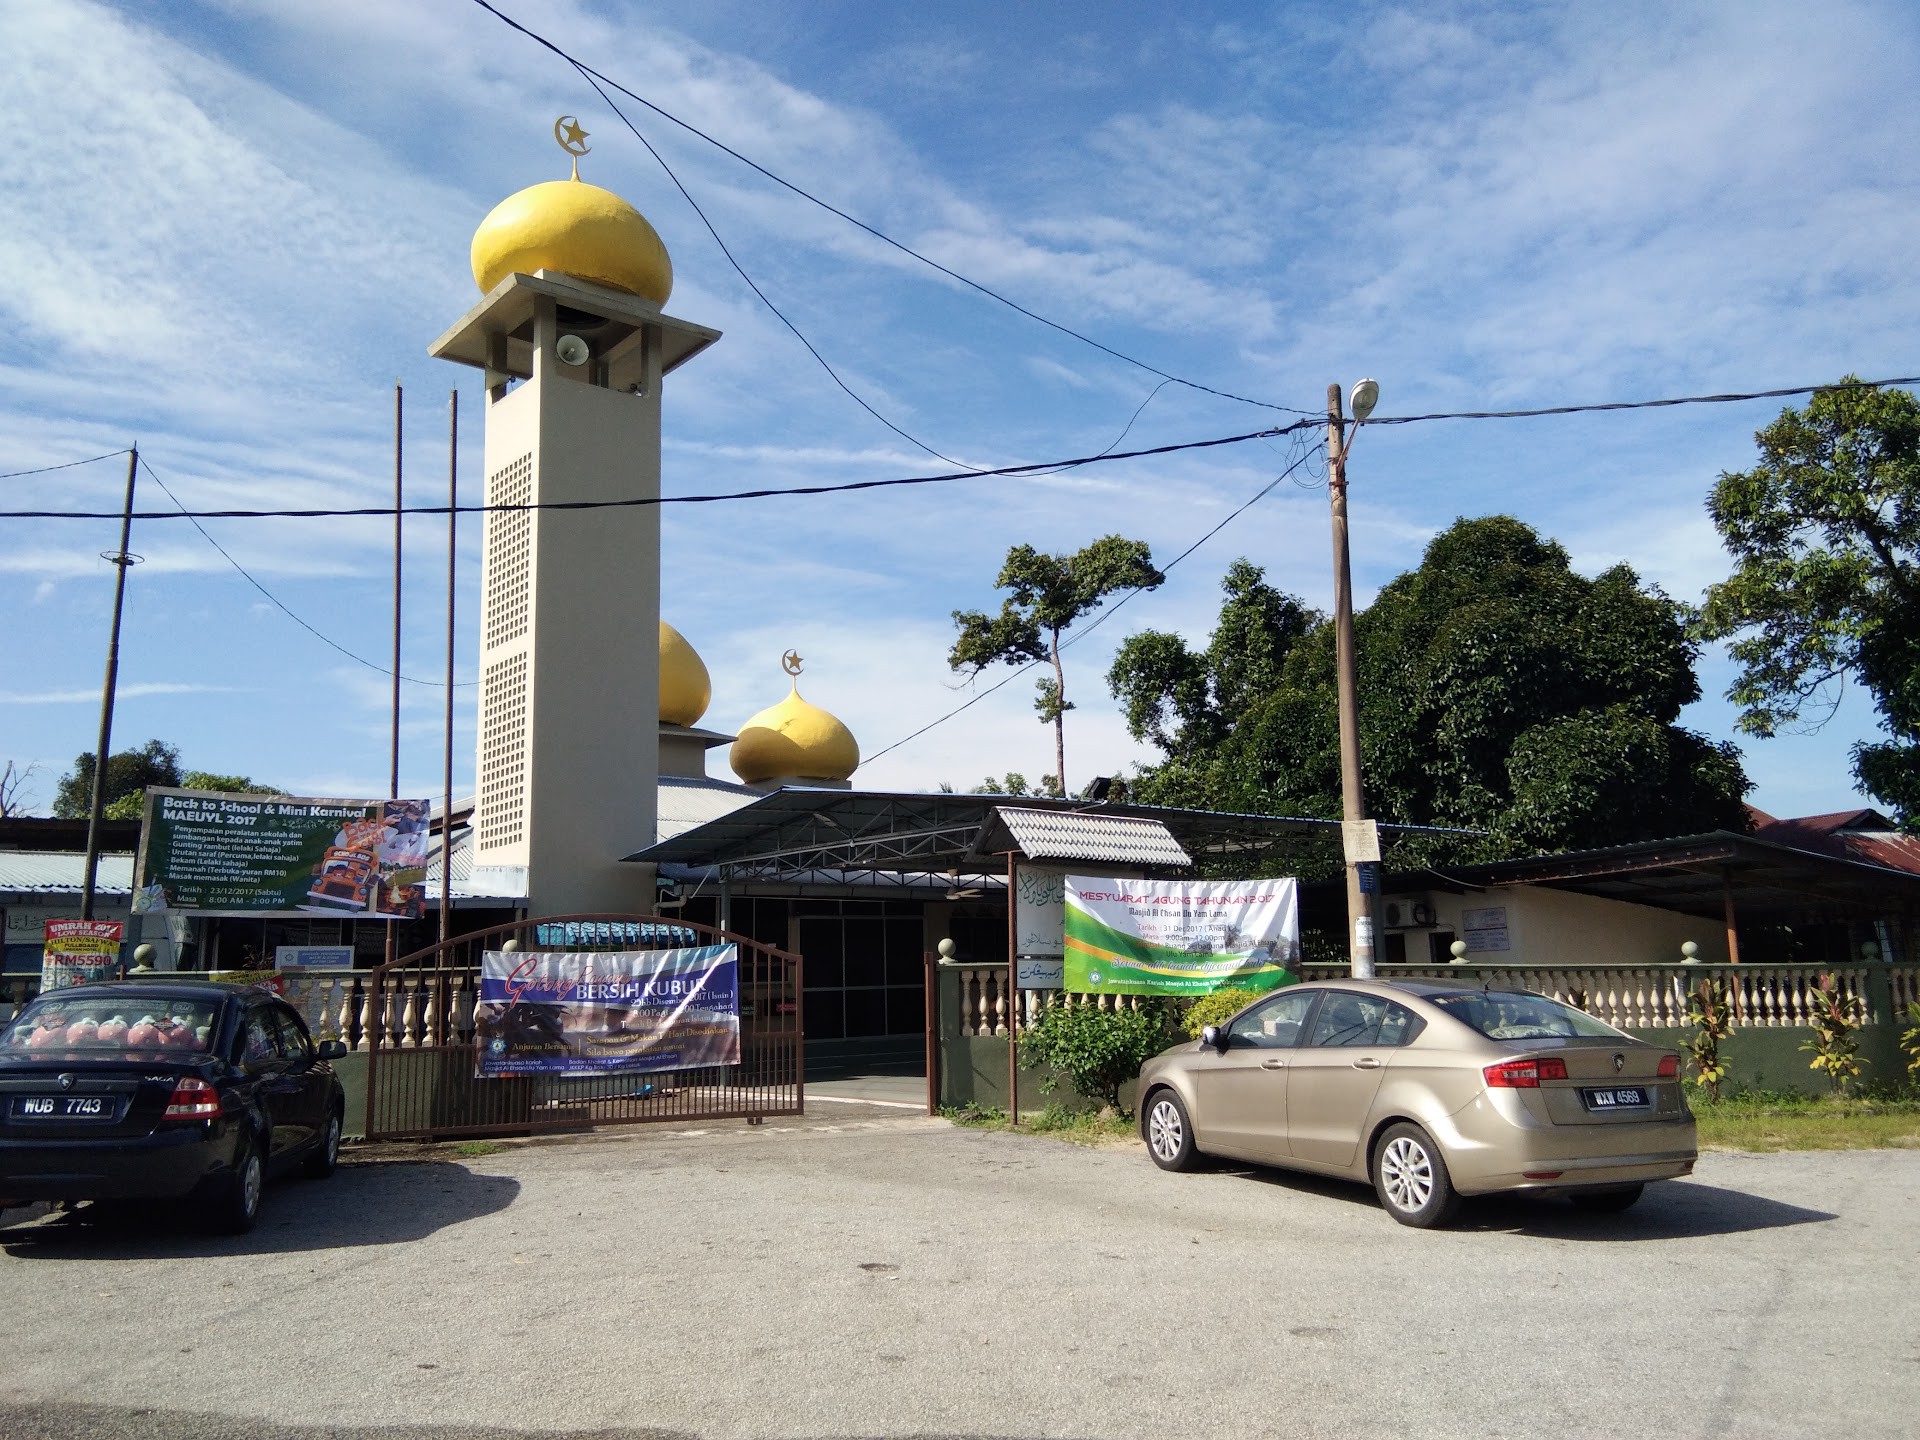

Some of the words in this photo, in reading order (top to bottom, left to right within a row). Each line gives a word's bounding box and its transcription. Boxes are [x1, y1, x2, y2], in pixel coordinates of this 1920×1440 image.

[163, 797, 199, 810] Back
[202, 801, 216, 811] to
[220, 801, 261, 814] School
[264, 804, 275, 815] &
[279, 805, 306, 816] Mini
[310, 807, 367, 818] Karnival
[163, 809, 223, 823] MAEUYL
[226, 815, 258, 826] 2017
[175, 825, 223, 835] Penyampaian
[225, 829, 260, 837] peralatan
[260, 829, 288, 838] sekolah
[289, 831, 302, 839] dan
[172, 841, 202, 850] Gunting
[204, 842, 230, 850] rambut
[173, 833, 215, 843] sumbangan
[216, 835, 243, 844] kepada
[244, 837, 281, 846] anak-anak
[282, 839, 302, 847] yatim
[172, 848, 197, 857] Urutan
[198, 850, 217, 858] saraf
[170, 864, 206, 873] Memanah
[264, 868, 287, 877] RM10)
[168, 872, 192, 880] Masak
[193, 874, 228, 882] memasak
[230, 875, 260, 884] (Wanita)
[210, 887, 254, 896] 23/12/2017
[255, 888, 281, 896] (Sabtu)
[177, 895, 197, 903] Masa
[208, 896, 227, 904] 8:00
[1079, 891, 1149, 904] MESYUARAT
[1152, 896, 1190, 905] AGUNG
[1194, 896, 1248, 905] TAHUNAN
[1249, 895, 1275, 904] 2017
[1128, 907, 1151, 918] Masjid
[1160, 909, 1181, 917] Ehsan
[1193, 910, 1207, 918] Yam
[50, 922, 92, 932] UMRAH
[55, 955, 112, 966] RM5590
[505, 958, 575, 1008] Gotong
[577, 982, 639, 1000] BERSIH
[645, 978, 706, 997] KUBUR
[1108, 978, 1146, 986] Jawatankuasa
[1165, 980, 1184, 988] Masjid
[586, 1035, 619, 1044] Sarapan
[630, 1034, 658, 1042] Makan
[686, 1026, 728, 1037] Disediakan
[512, 1043, 542, 1051] Anjuran
[586, 1047, 601, 1056] Sila
[602, 1047, 624, 1056] bawa
[1594, 1091, 1616, 1105] WXW
[1616, 1090, 1640, 1104] 4569
[24, 1098, 54, 1114] WUB
[66, 1098, 102, 1114] 7743
